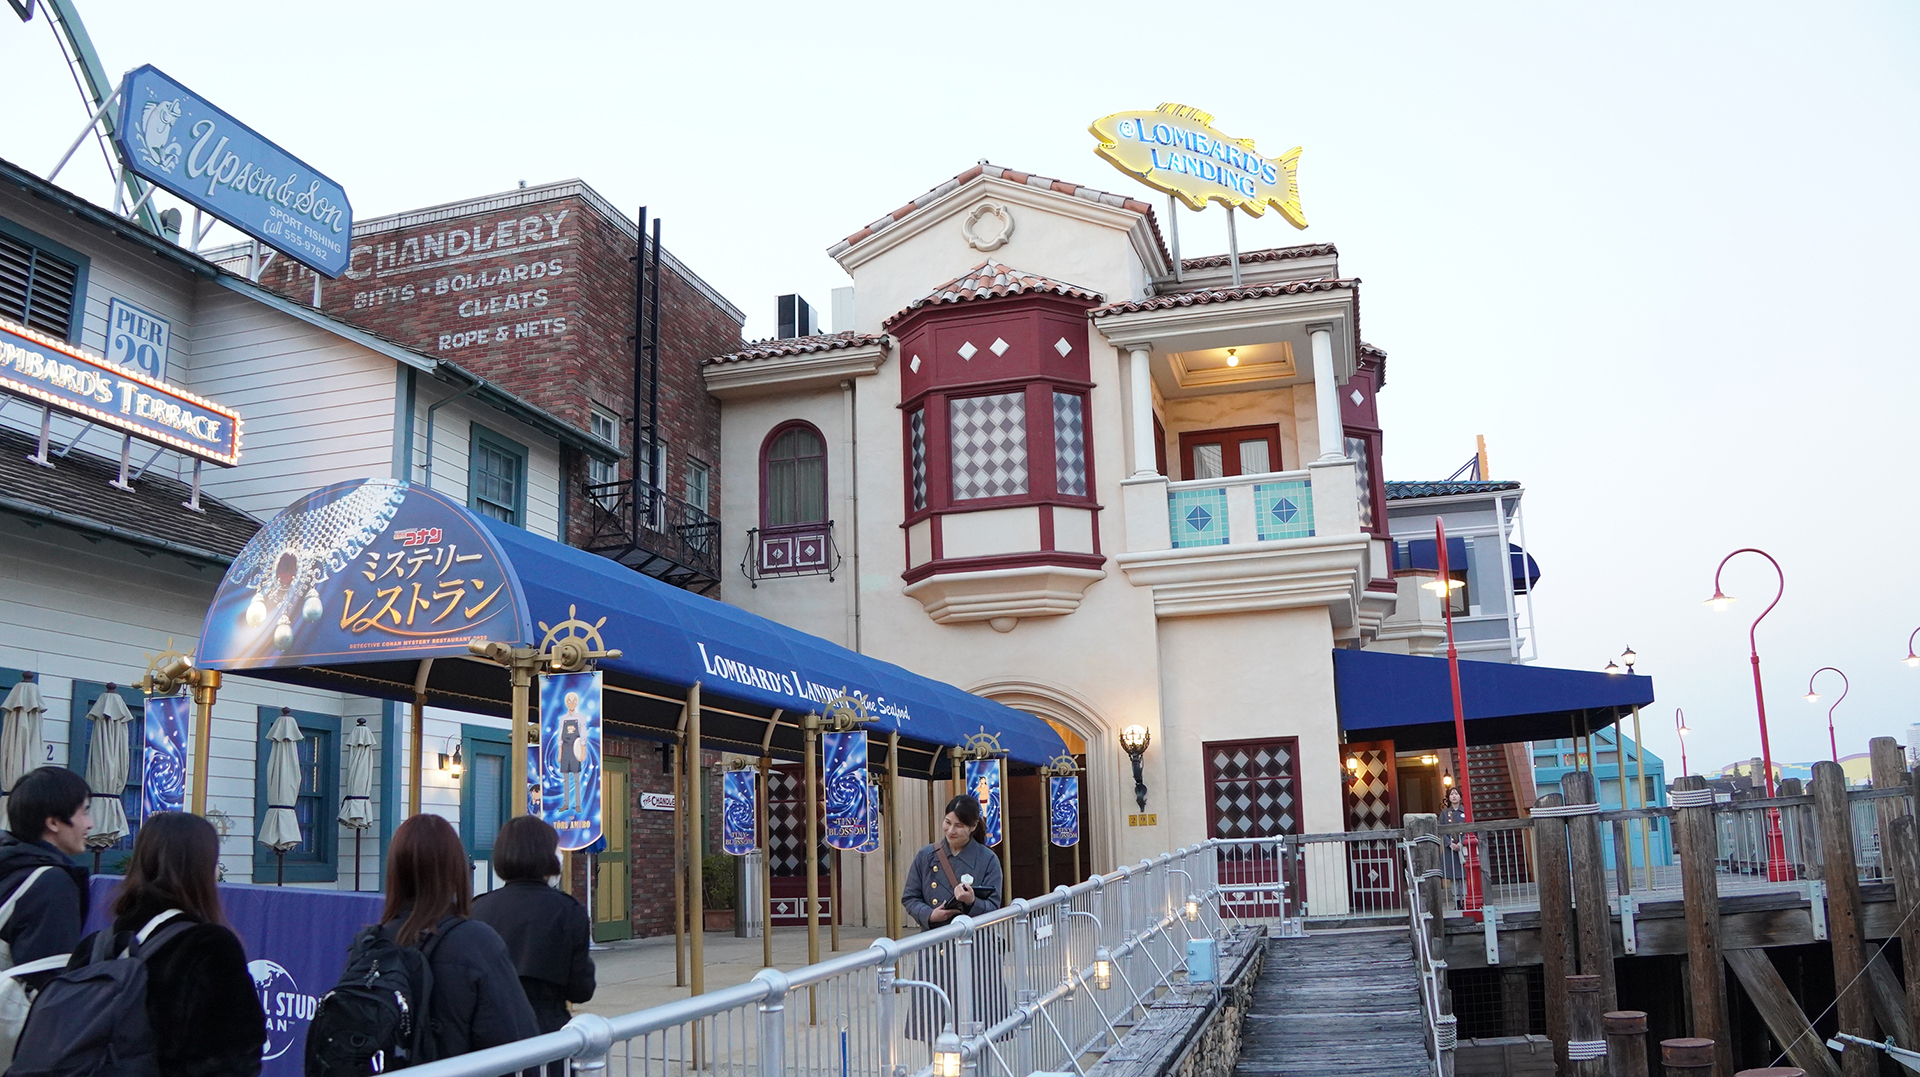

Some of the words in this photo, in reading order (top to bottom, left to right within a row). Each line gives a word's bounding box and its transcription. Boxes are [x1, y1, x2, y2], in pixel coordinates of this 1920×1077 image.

[1134, 118, 1277, 185] LOMBARD'S
[1151, 148, 1256, 199] LANDING
[187, 119, 276, 197] Upson
[276, 174, 295, 206] &
[293, 180, 343, 233] Son
[263, 219, 282, 236] Call
[284, 230, 327, 261] 555-9782
[269, 206, 302, 231] SPORT
[304, 226, 342, 253] FISHING
[344, 209, 570, 280] CHANDLERY
[354, 284, 415, 309] BITTS
[435, 259, 564, 296] BOLLARDS
[458, 289, 549, 318] CLEATS
[116, 306, 164, 347] PIER
[438, 329, 489, 351] ROPE
[495, 326, 509, 342] &
[515, 317, 567, 339] NETS
[115, 334, 160, 381] 29
[0, 341, 113, 403] MBARD'S
[117, 381, 222, 443] TERRACE
[361, 544, 483, 582] ミステリー
[340, 579, 506, 631] レストラン
[432, 636, 471, 644] RESTAURANT
[697, 642, 794, 696] LOMBARD'S
[877, 697, 911, 728] Seafood
[46, 744, 54, 761] 2
[828, 827, 867, 836] BLOSSOM
[836, 817, 858, 826] TINY
